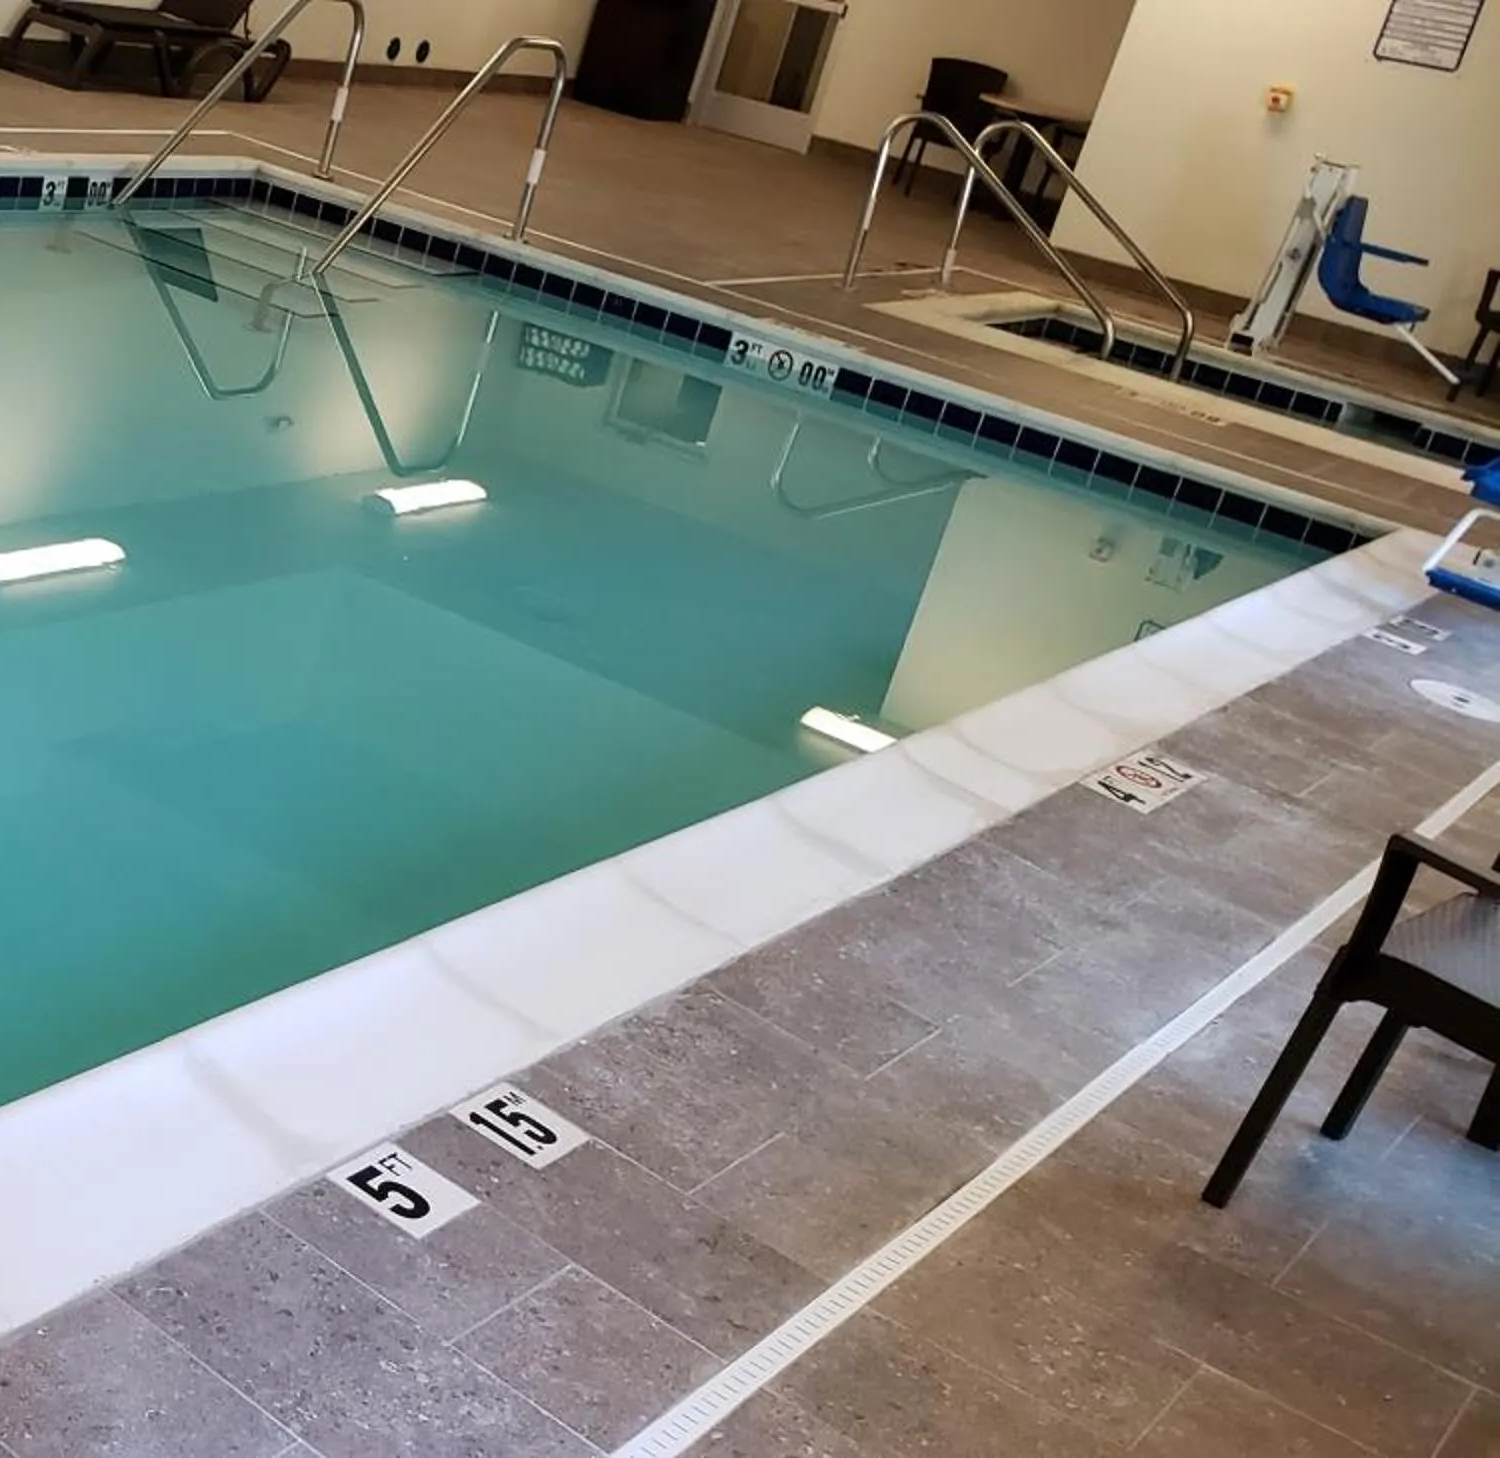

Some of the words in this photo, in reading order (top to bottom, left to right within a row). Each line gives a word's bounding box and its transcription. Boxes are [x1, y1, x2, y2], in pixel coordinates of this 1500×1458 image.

[731, 340, 749, 365] 3
[378, 1152, 413, 1177] FT
[346, 1164, 431, 1220] 5
